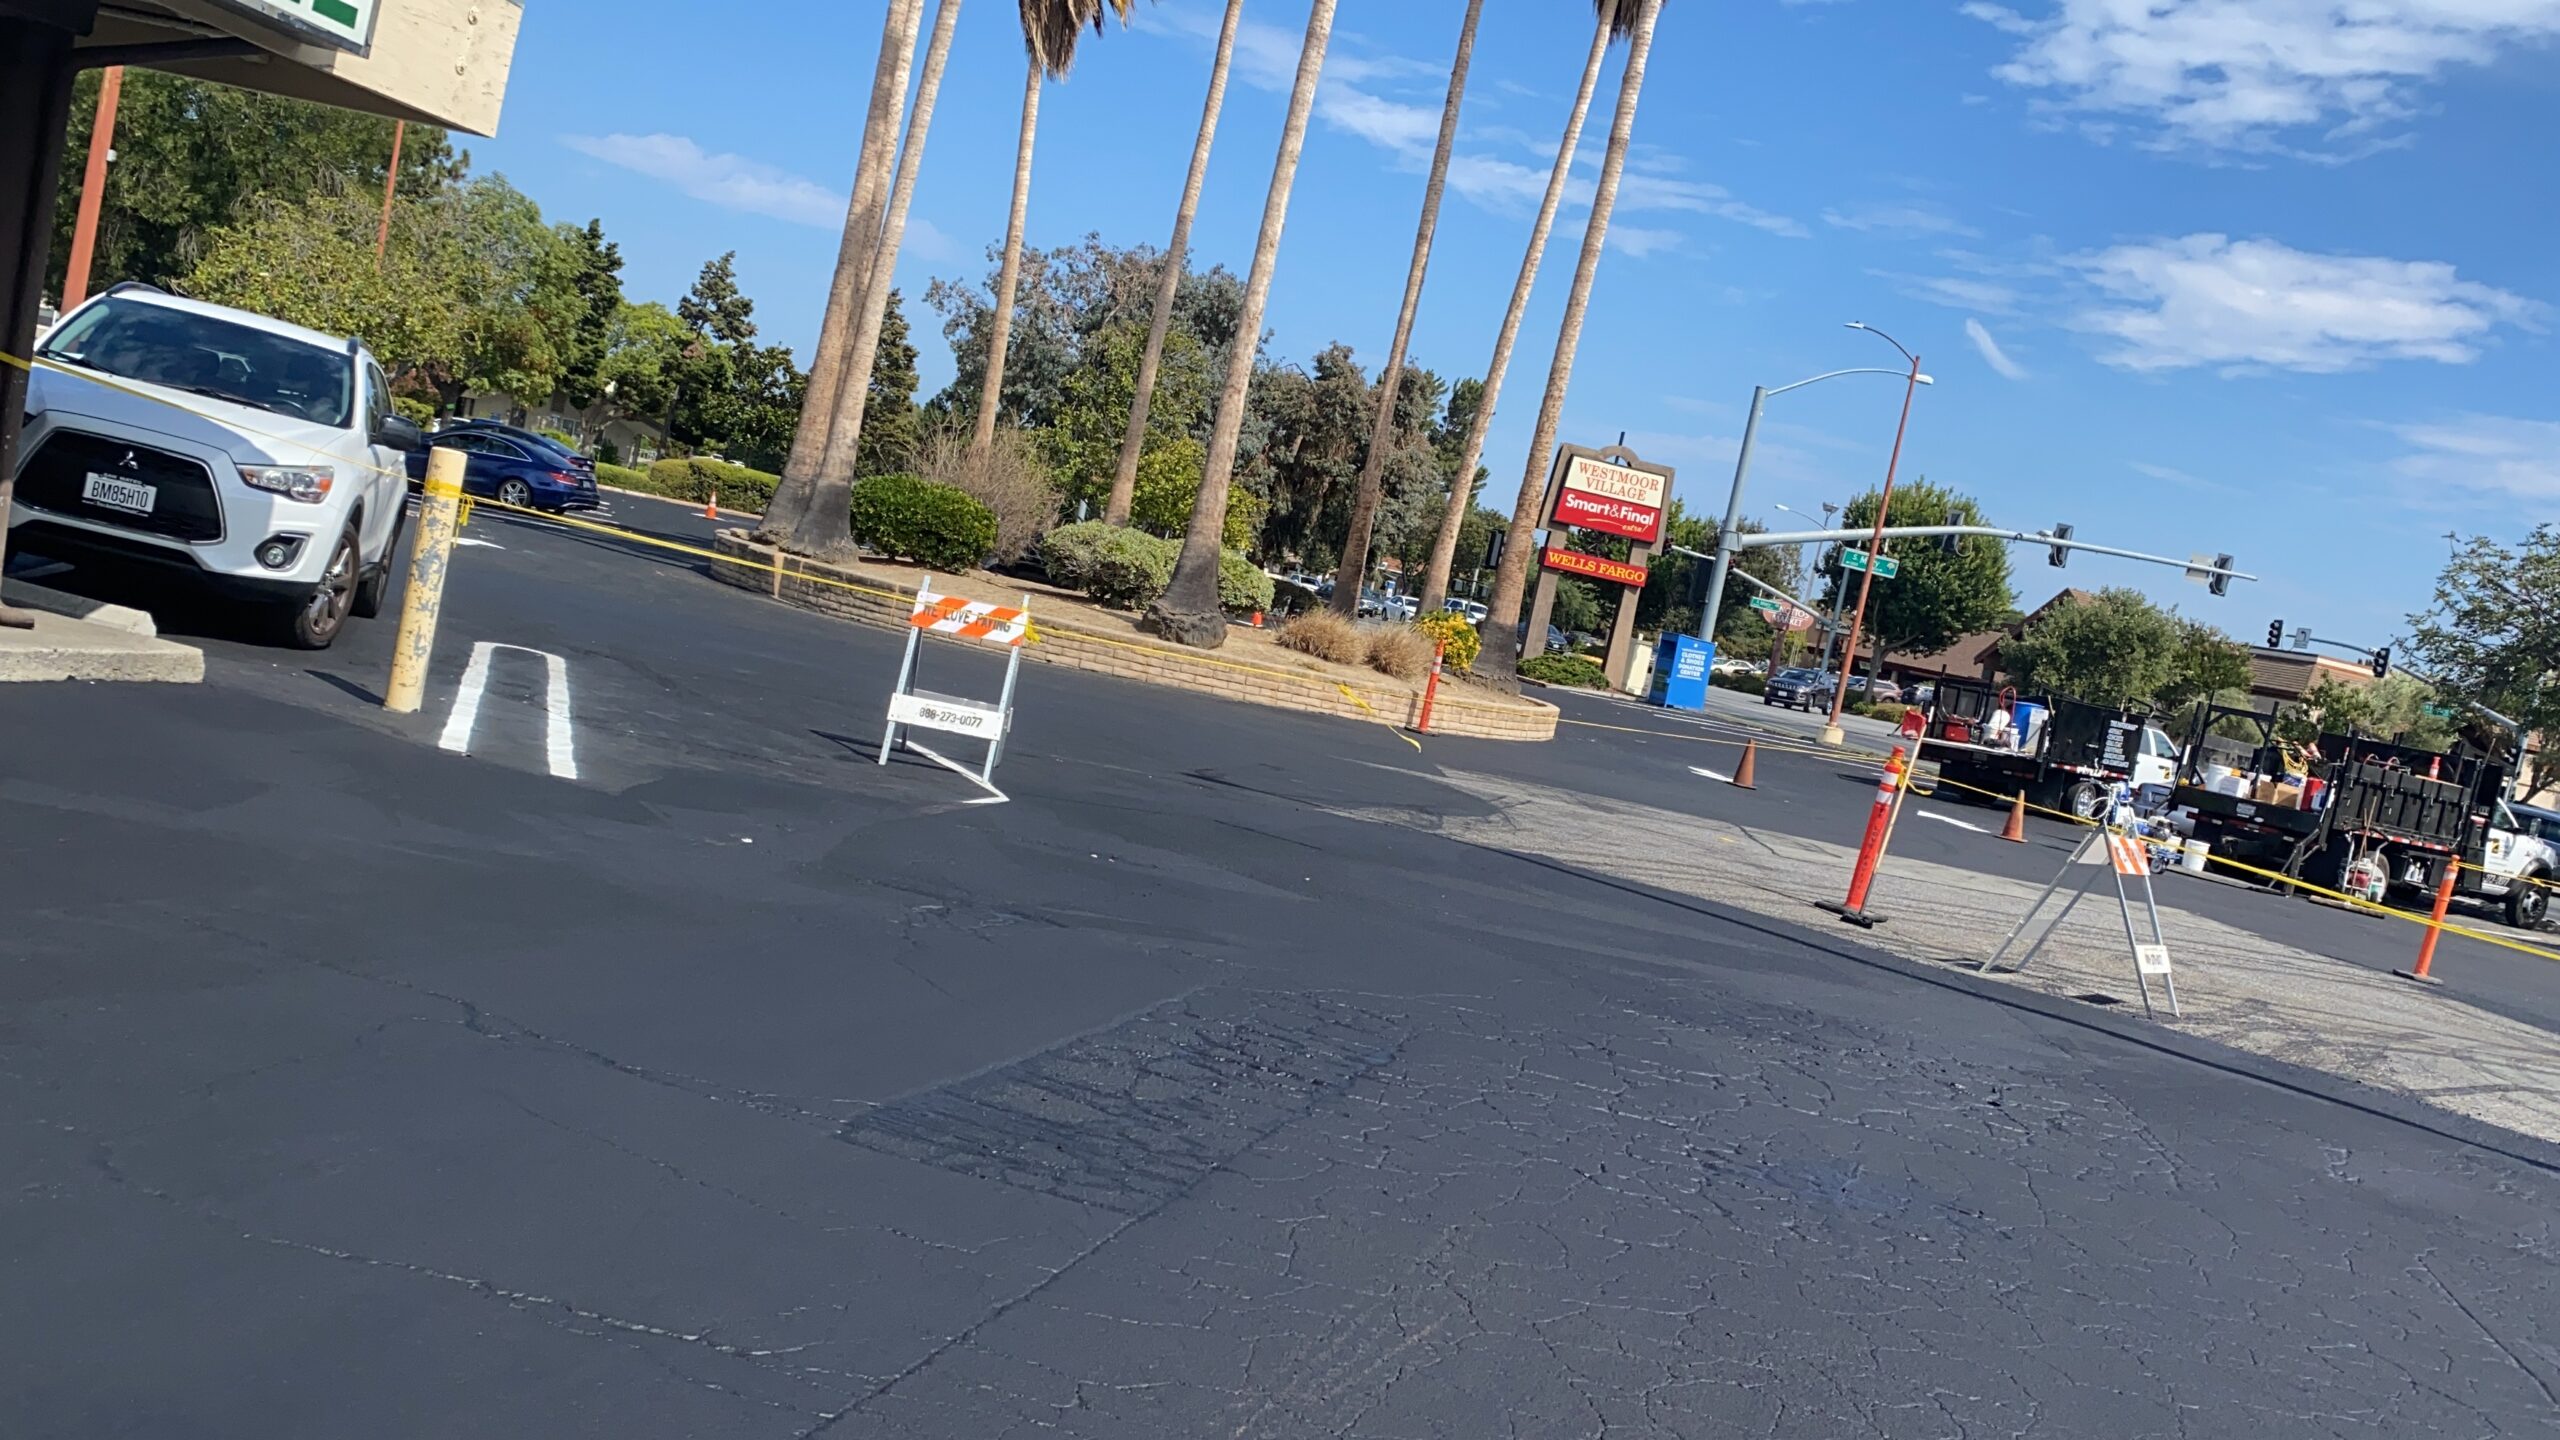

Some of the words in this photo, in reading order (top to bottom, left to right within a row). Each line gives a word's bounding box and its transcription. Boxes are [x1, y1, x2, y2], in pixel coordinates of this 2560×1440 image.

[1579, 462, 1659, 491] WESTMOOR
[1586, 477, 1646, 500] VILLAGE
[91, 481, 148, 508] BM85H10
[1565, 494, 1655, 525] Smart&Final
[1549, 551, 1597, 571] WELLS
[1598, 563, 1645, 582] FARGO
[943, 606, 972, 624] LOVE
[975, 612, 1011, 632] PAVING
[919, 707, 983, 728] 888-273-0077
